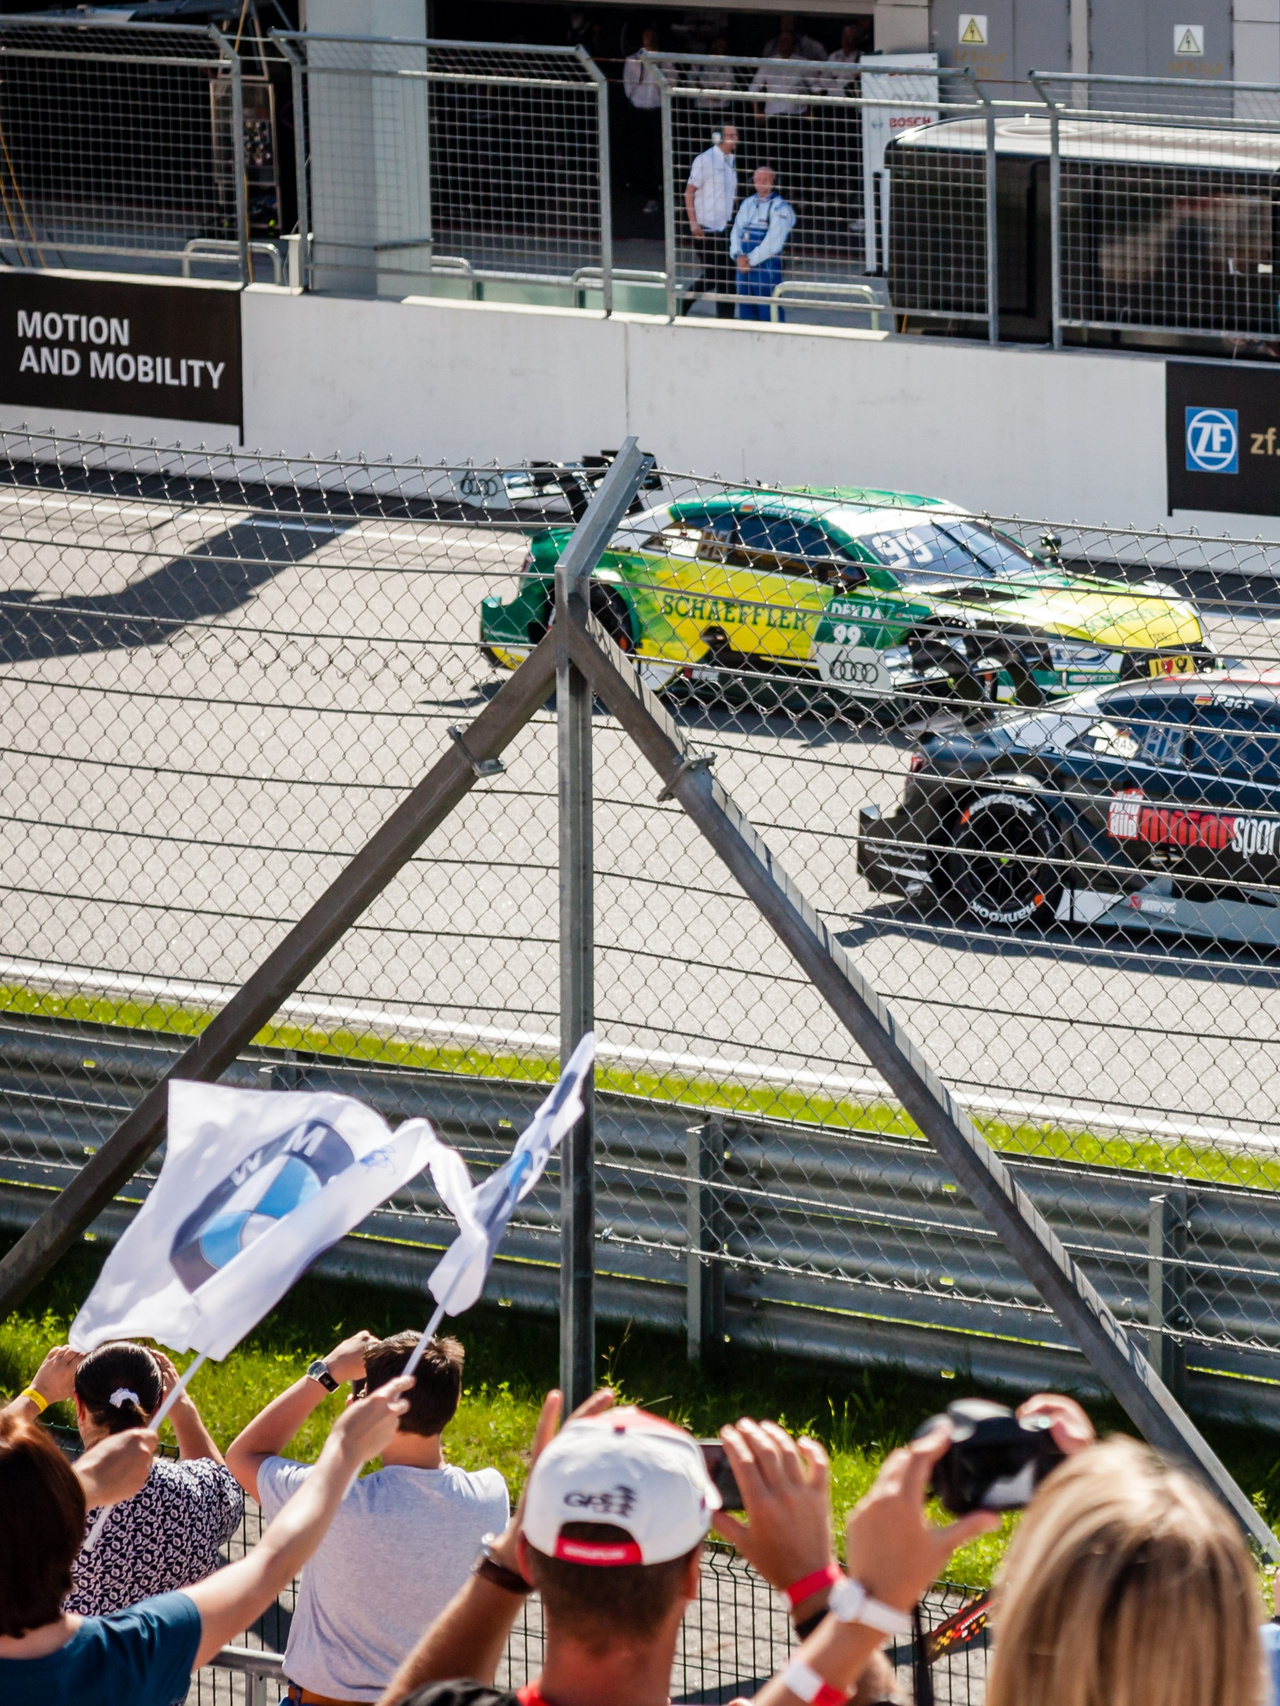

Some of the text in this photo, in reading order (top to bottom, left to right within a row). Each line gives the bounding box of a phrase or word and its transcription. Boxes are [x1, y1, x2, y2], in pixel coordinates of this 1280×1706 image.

[888, 116, 932, 128] BOSCH
[17, 309, 130, 346] MOTION
[19, 345, 226, 390] AND MOBILITY
[871, 532, 934, 568] 99
[663, 594, 807, 630] SCHAEFFLER
[831, 602, 883, 620] DEKRA
[833, 624, 862, 646] 99
[971, 901, 1036, 923] Hankook
